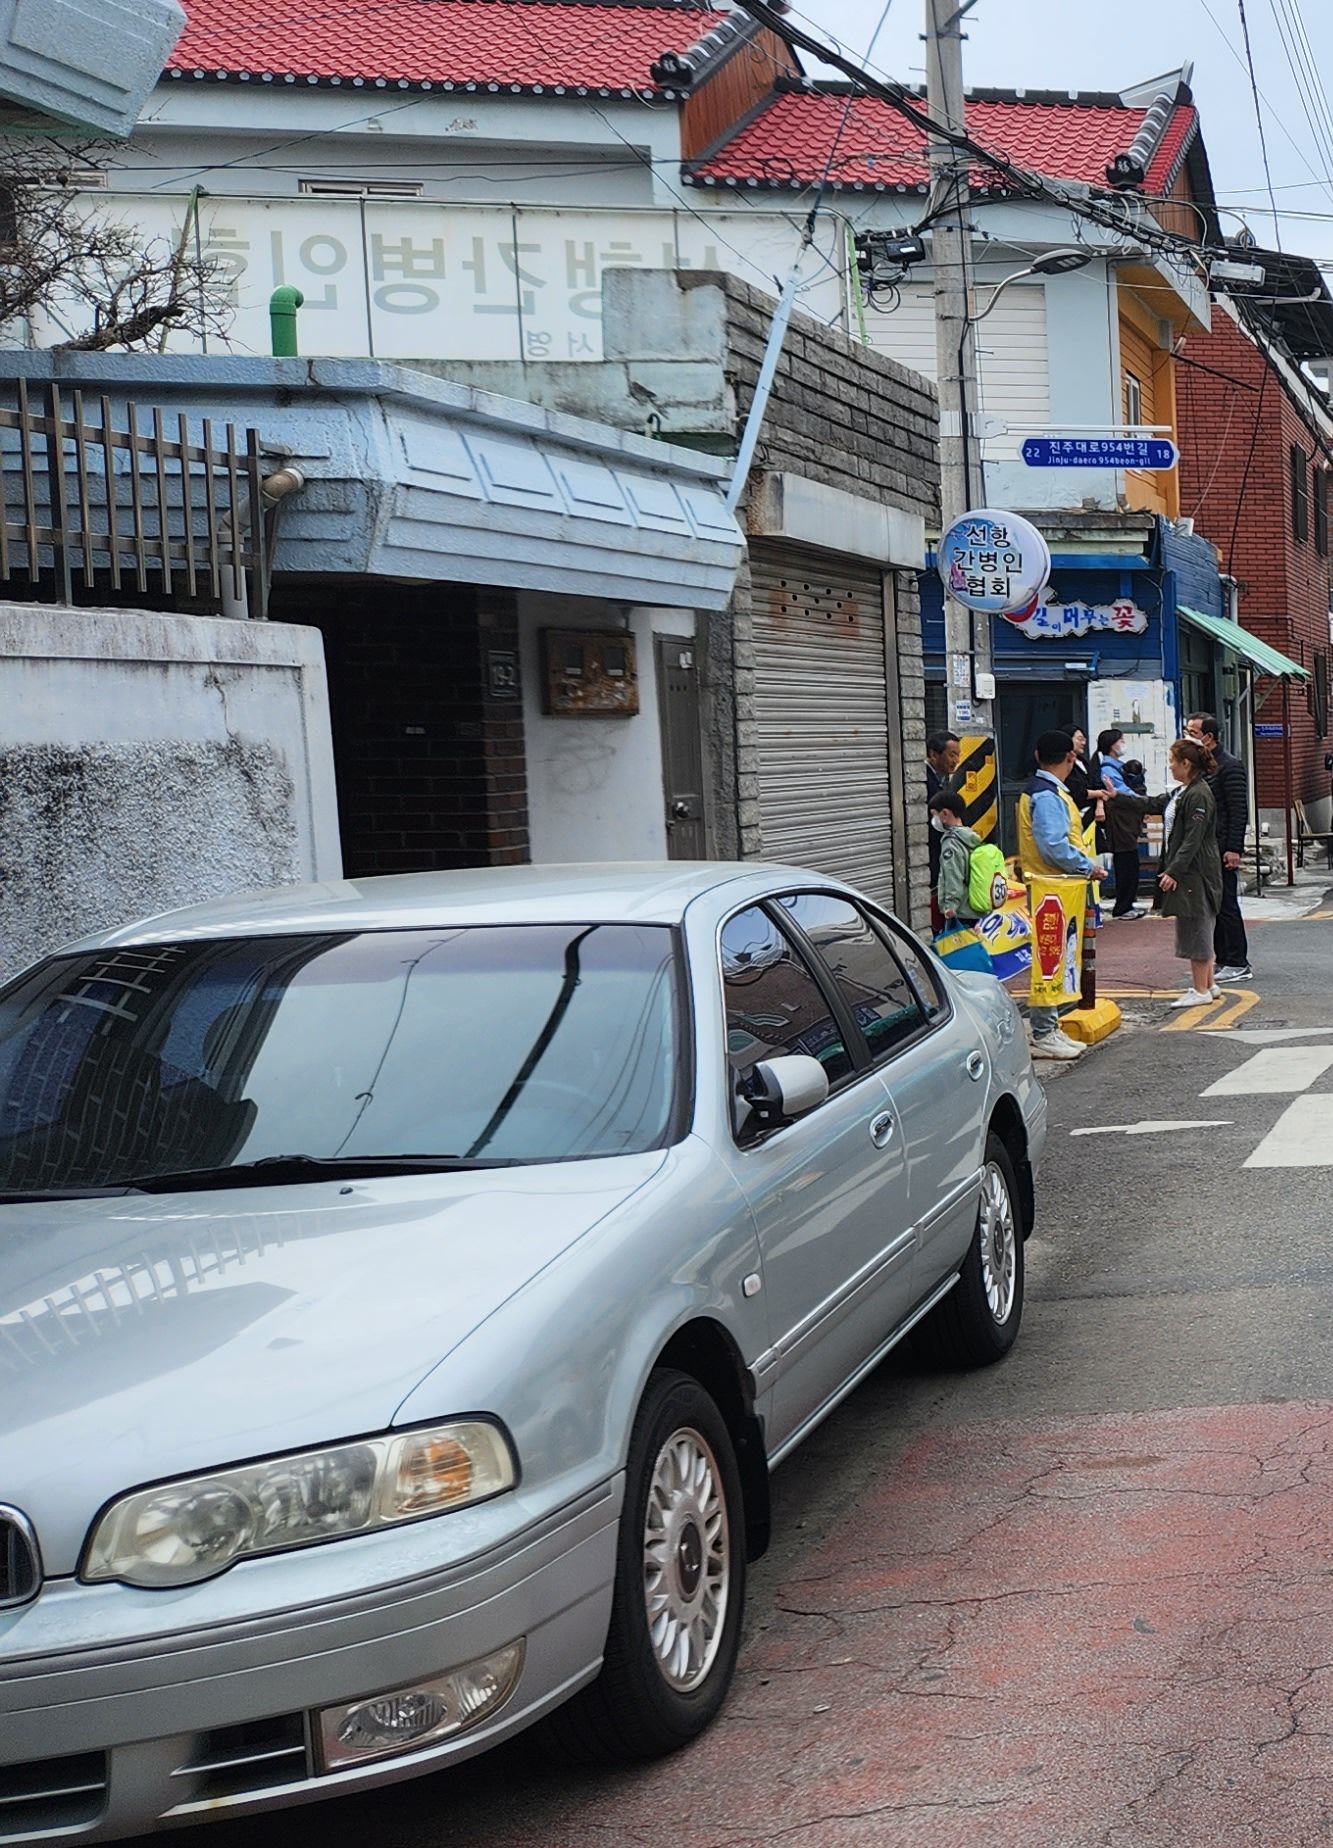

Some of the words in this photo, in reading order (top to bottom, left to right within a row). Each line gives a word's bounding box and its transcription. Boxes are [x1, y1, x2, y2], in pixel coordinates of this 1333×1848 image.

[1025, 447, 1041, 459] 22
[1049, 441, 1149, 456] 진주대로954번길
[1157, 449, 1171, 460] 18
[1048, 455, 1097, 465] Jinju-daero
[1099, 456, 1151, 467] 954beon-gil
[954, 550, 1023, 574] 간병인
[966, 575, 1011, 599] 협회
[1111, 605, 1136, 630] 꽃
